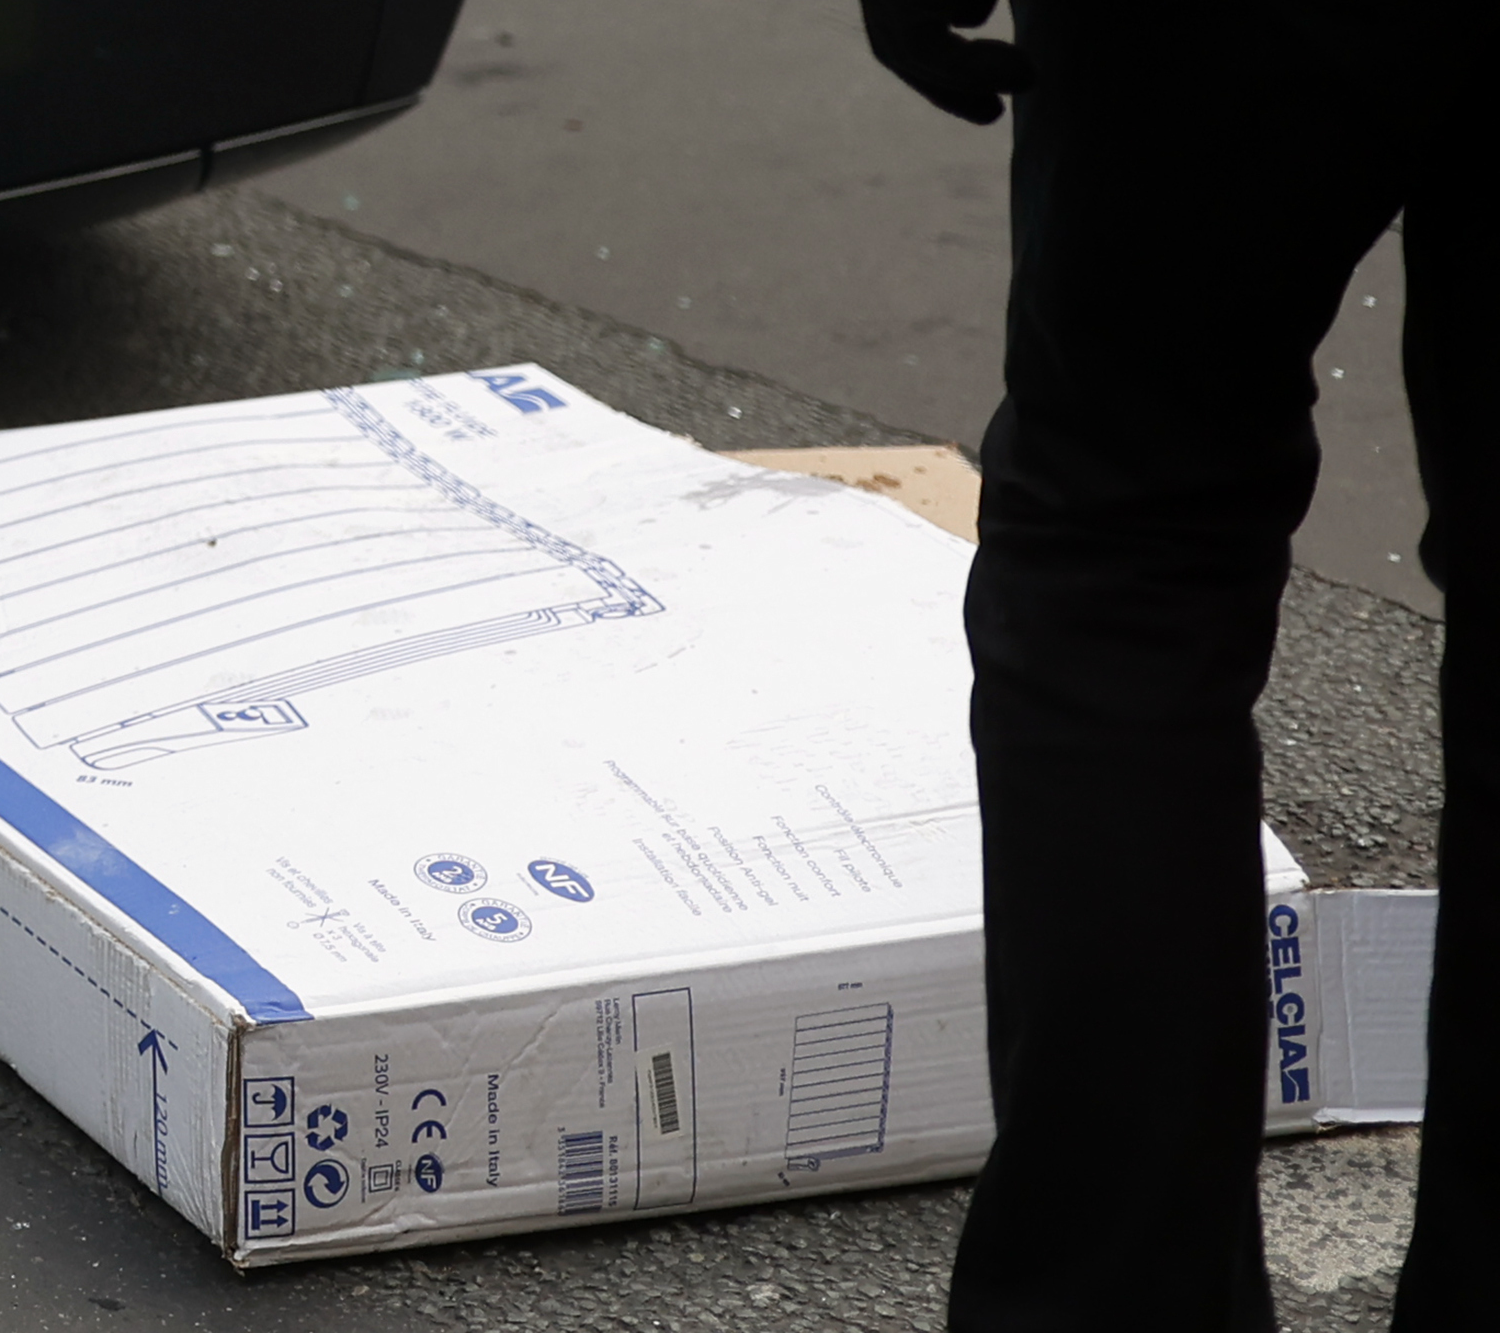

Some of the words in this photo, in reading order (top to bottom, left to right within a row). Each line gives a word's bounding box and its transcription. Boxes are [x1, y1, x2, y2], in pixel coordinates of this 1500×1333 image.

[632, 838, 679, 890] Installation
[676, 889, 702, 916] facile
[670, 839, 732, 913] hebdomadaire
[707, 826, 743, 866] Position
[741, 866, 779, 907] Anti-gel
[753, 835, 791, 882] Fonction
[789, 882, 809, 902] nuit
[771, 815, 809, 860] Fonction
[807, 860, 841, 897] confort
[841, 863, 871, 893] pilote
[535, 863, 590, 898] NF
[698, 852, 748, 911] quotidienne
[368, 879, 400, 906] Made
[398, 906, 412, 918] in
[410, 917, 437, 942] Italy
[486, 912, 508, 924] 5
[1268, 904, 1308, 1072] CELCIA
[375, 1054, 389, 1095] 230V
[155, 1093, 169, 1139] 120
[412, 1089, 447, 1143] CE
[487, 1074, 499, 1126] Made
[375, 1110, 389, 1148] IP24
[488, 1131, 499, 1144] in
[609, 1135, 618, 1157] Réf.
[156, 1145, 169, 1191] mm
[421, 1158, 437, 1189] NF
[486, 1150, 500, 1187] Italy
